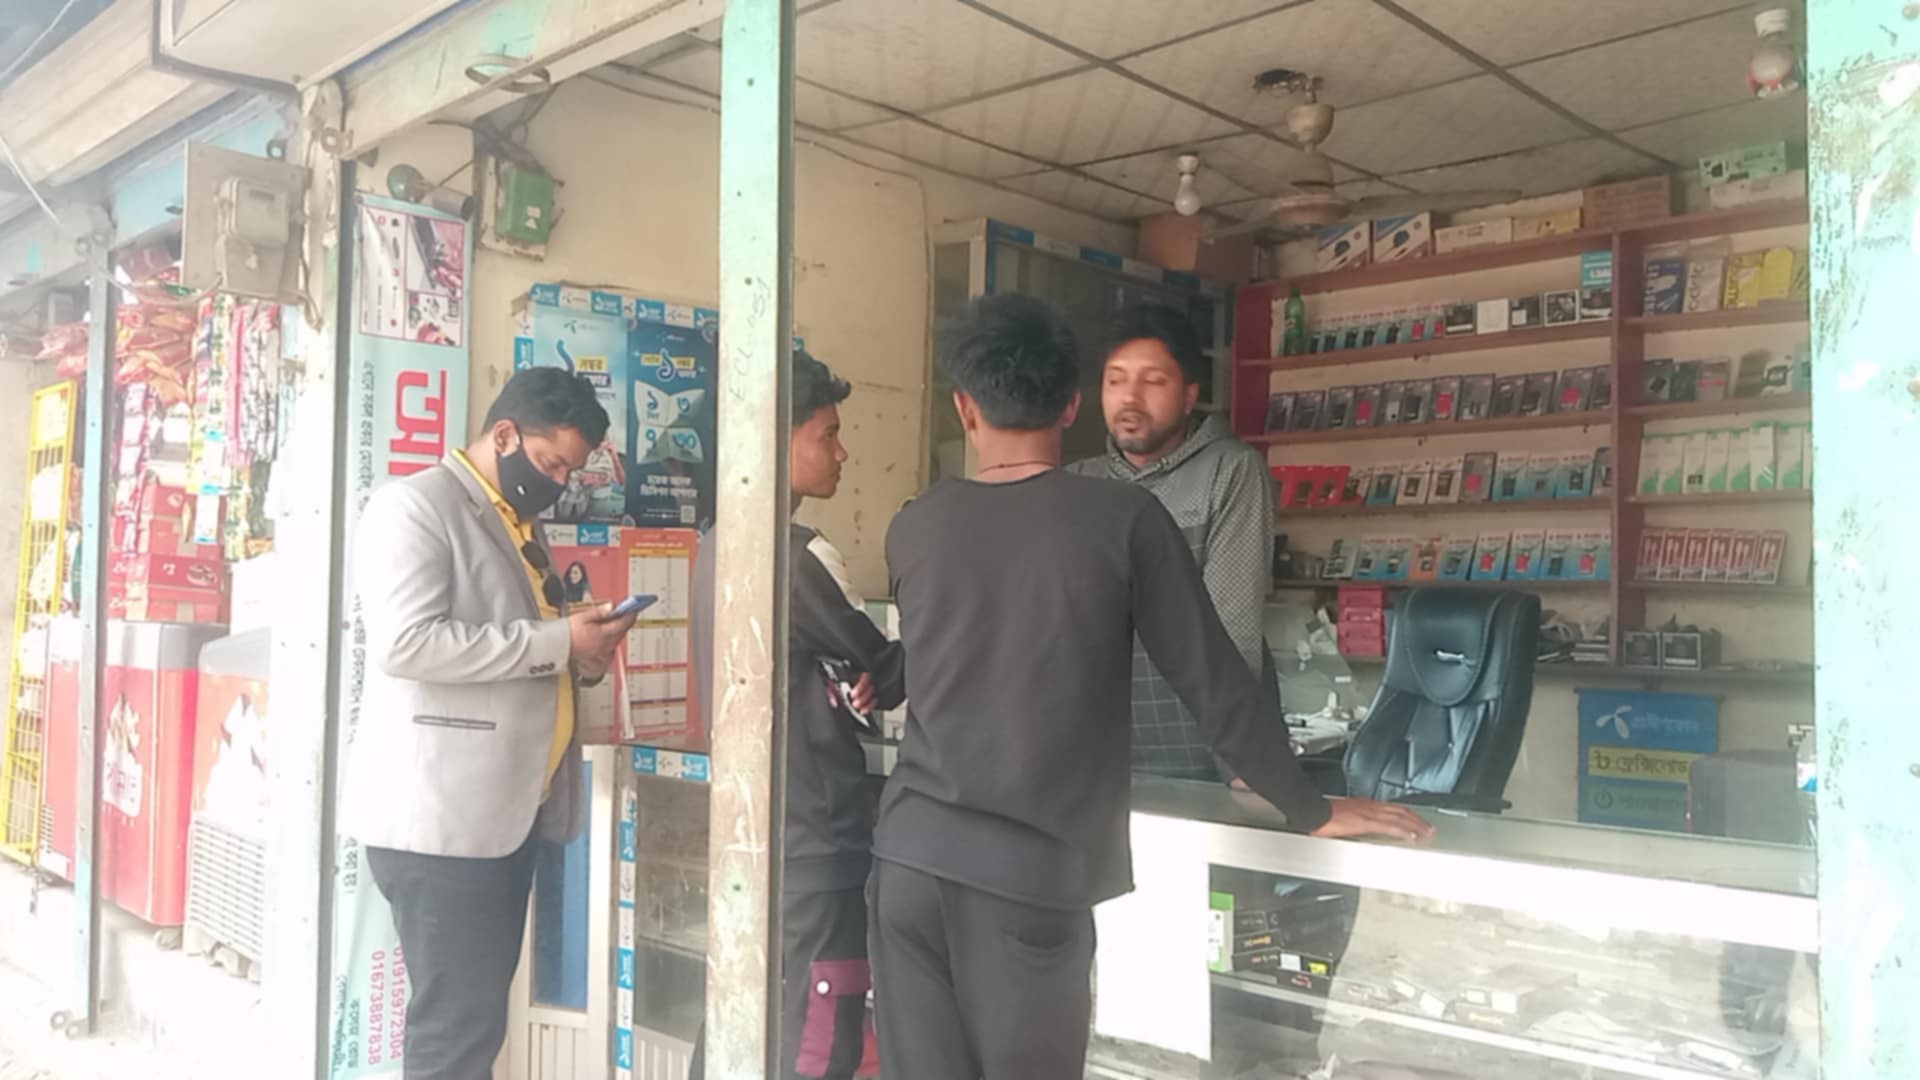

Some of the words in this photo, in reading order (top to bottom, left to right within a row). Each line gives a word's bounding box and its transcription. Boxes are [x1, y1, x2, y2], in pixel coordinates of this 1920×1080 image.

[361, 393, 375, 418] সকল
[387, 368, 447, 478] আ
[367, 950, 386, 1066] 01673887838
[388, 945, 407, 1060] 01915972304
